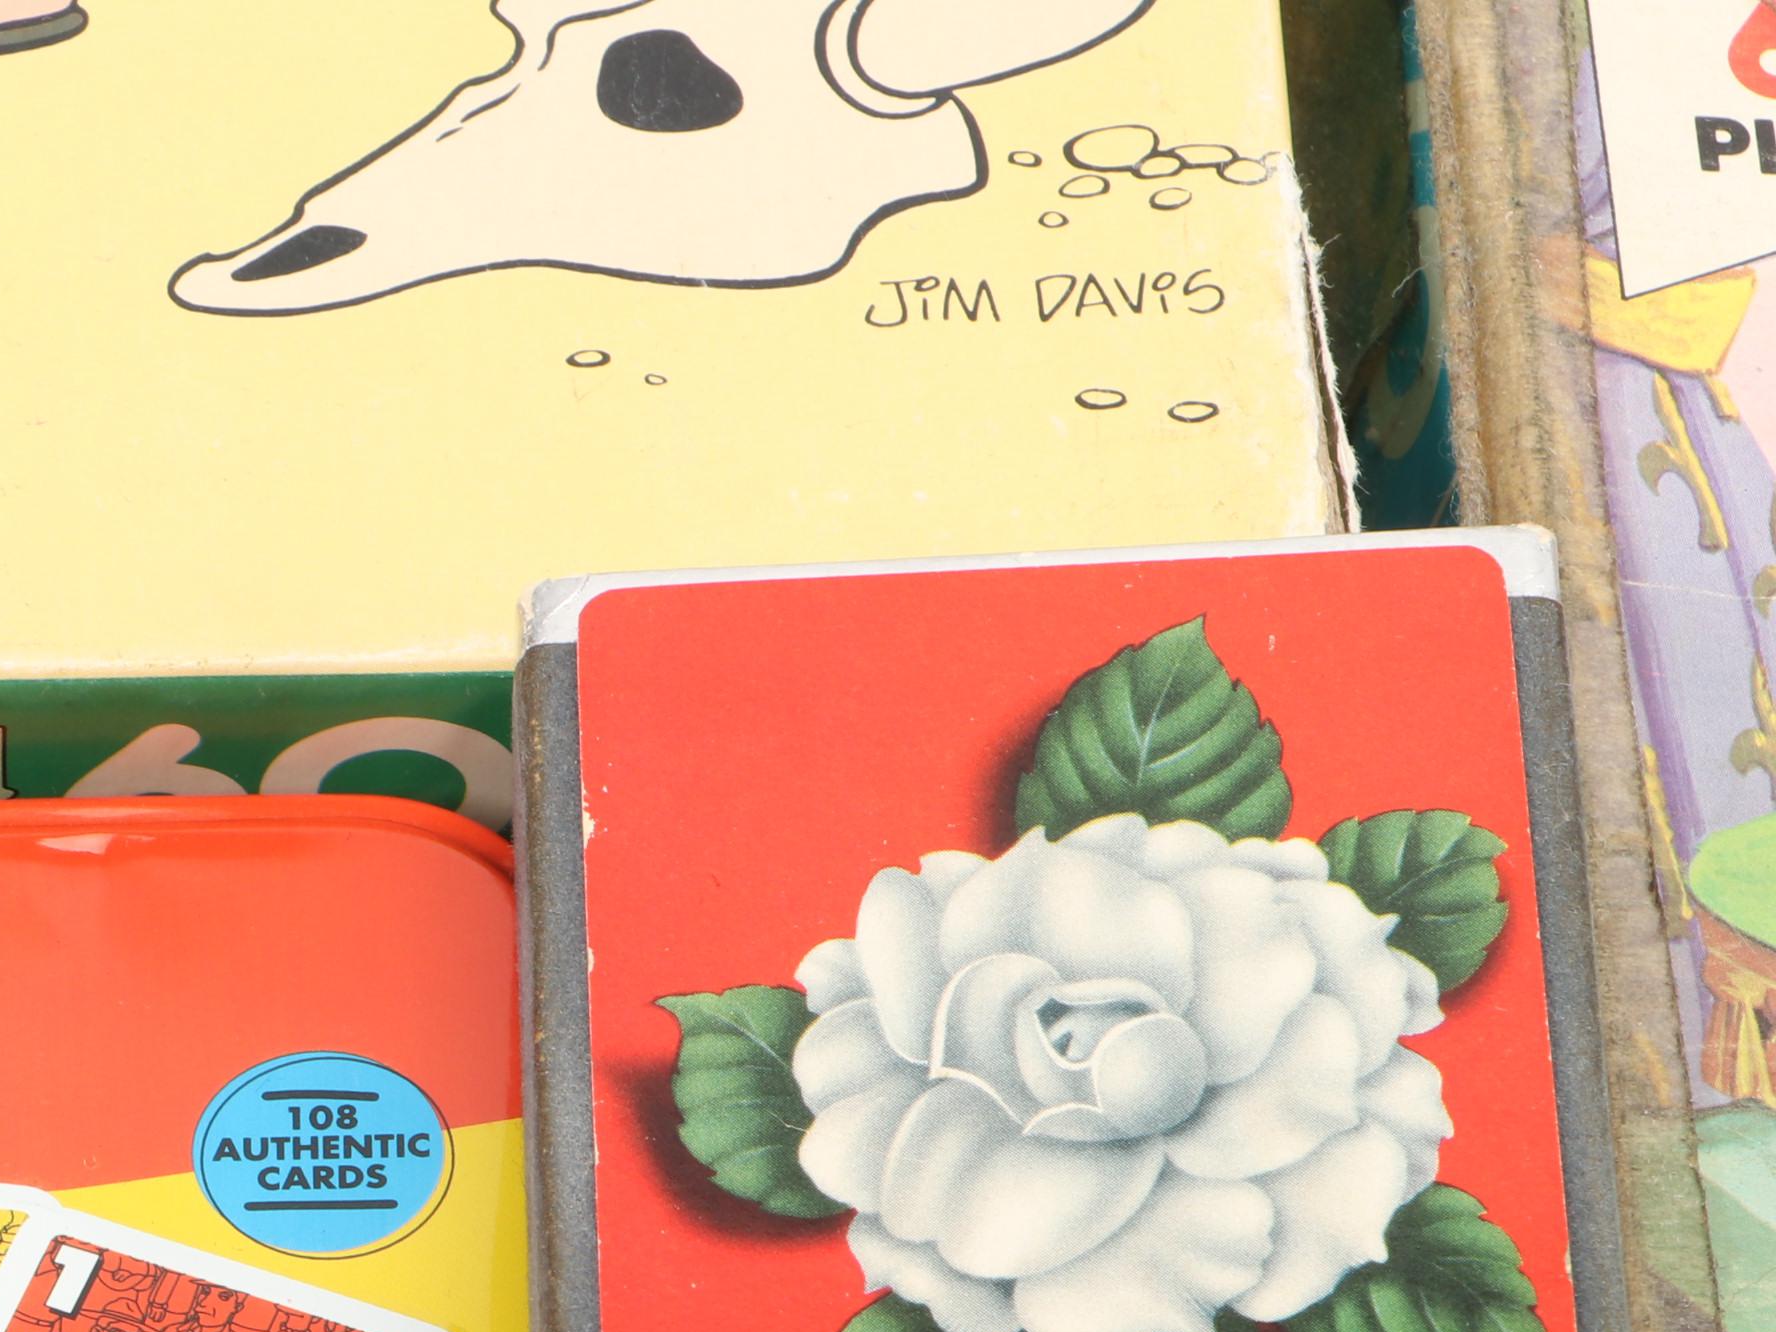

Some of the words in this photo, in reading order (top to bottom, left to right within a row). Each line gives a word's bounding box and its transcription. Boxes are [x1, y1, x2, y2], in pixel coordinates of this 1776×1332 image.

[288, 1105, 358, 1130] 108
[212, 1133, 431, 1161] AUTHENTIC
[257, 1164, 388, 1191] CARDS
